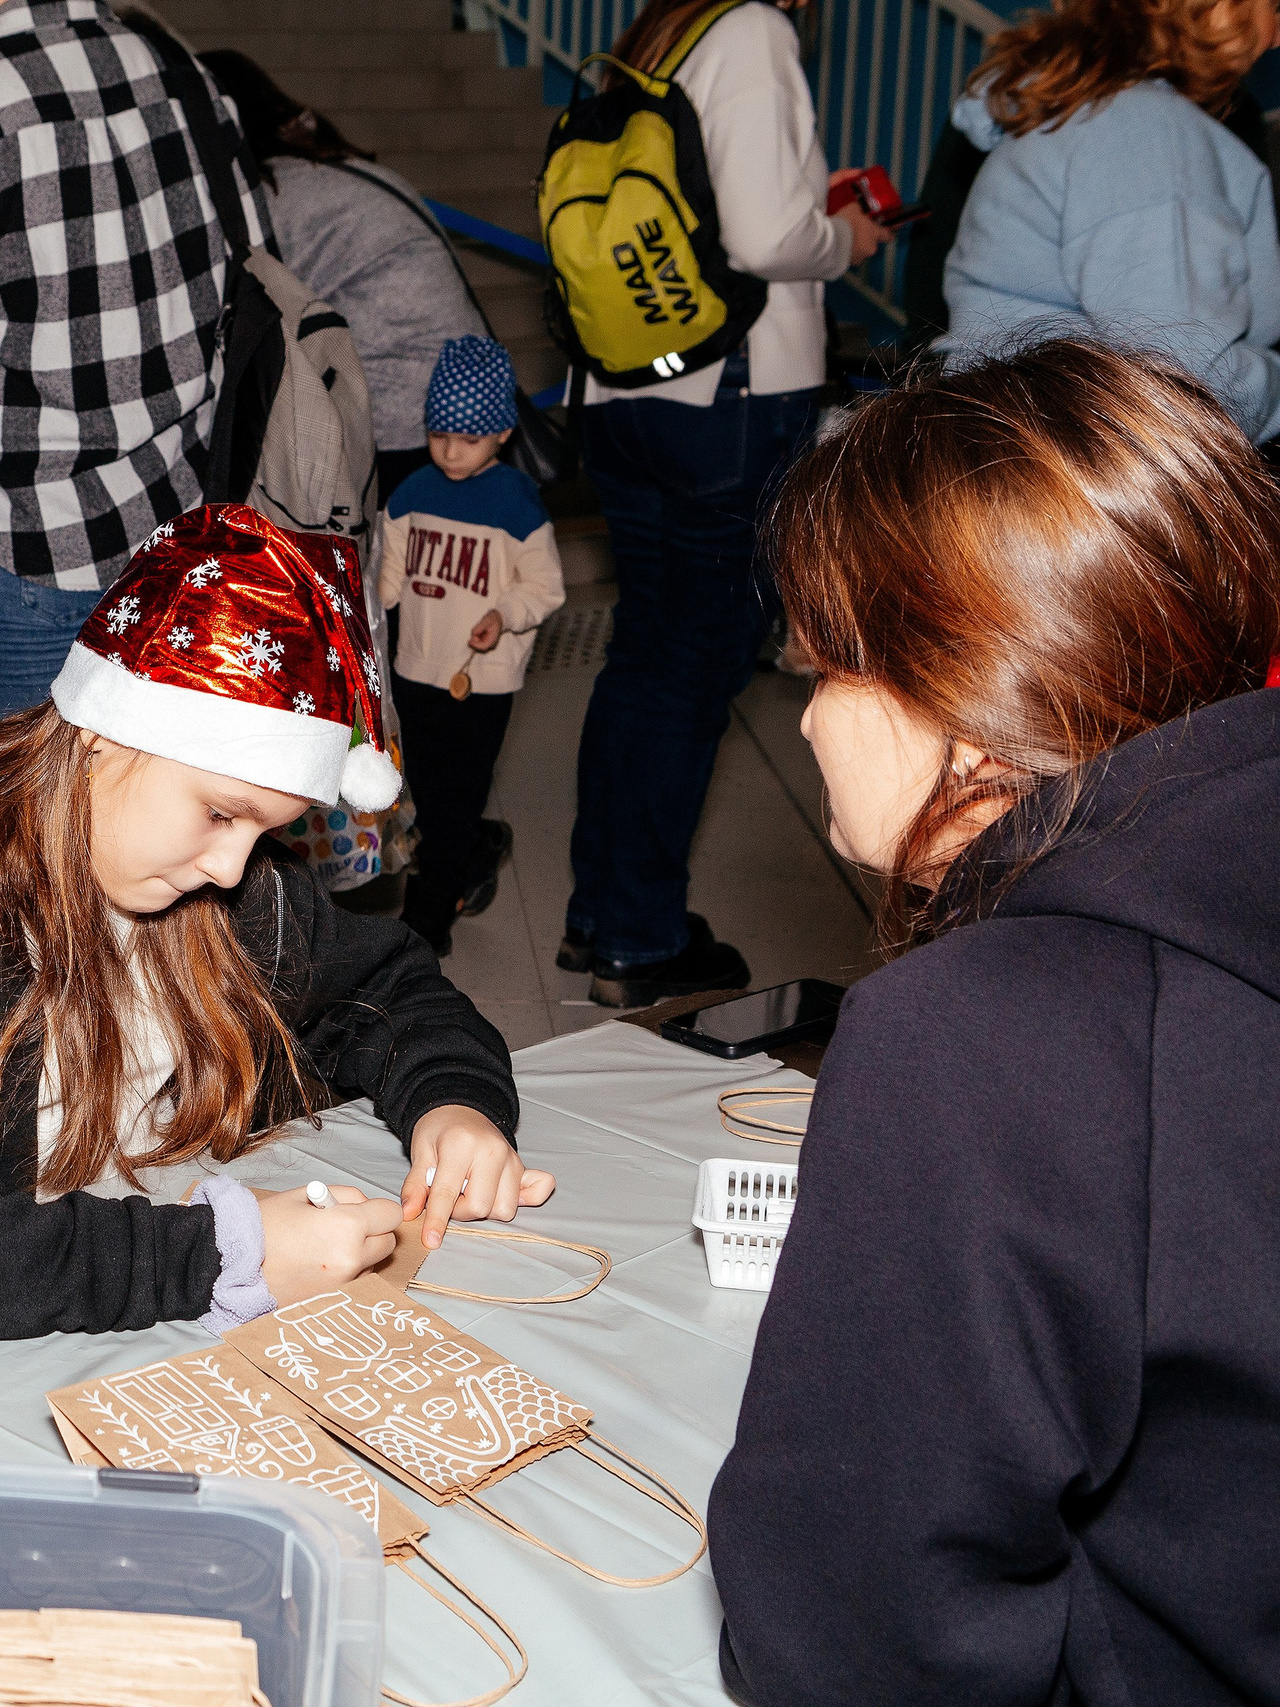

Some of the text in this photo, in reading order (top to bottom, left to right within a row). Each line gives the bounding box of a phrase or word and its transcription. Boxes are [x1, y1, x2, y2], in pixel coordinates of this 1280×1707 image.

[612, 241, 669, 324] MAD
[634, 218, 699, 325] WAVE
[405, 526, 491, 597] ONTANA
